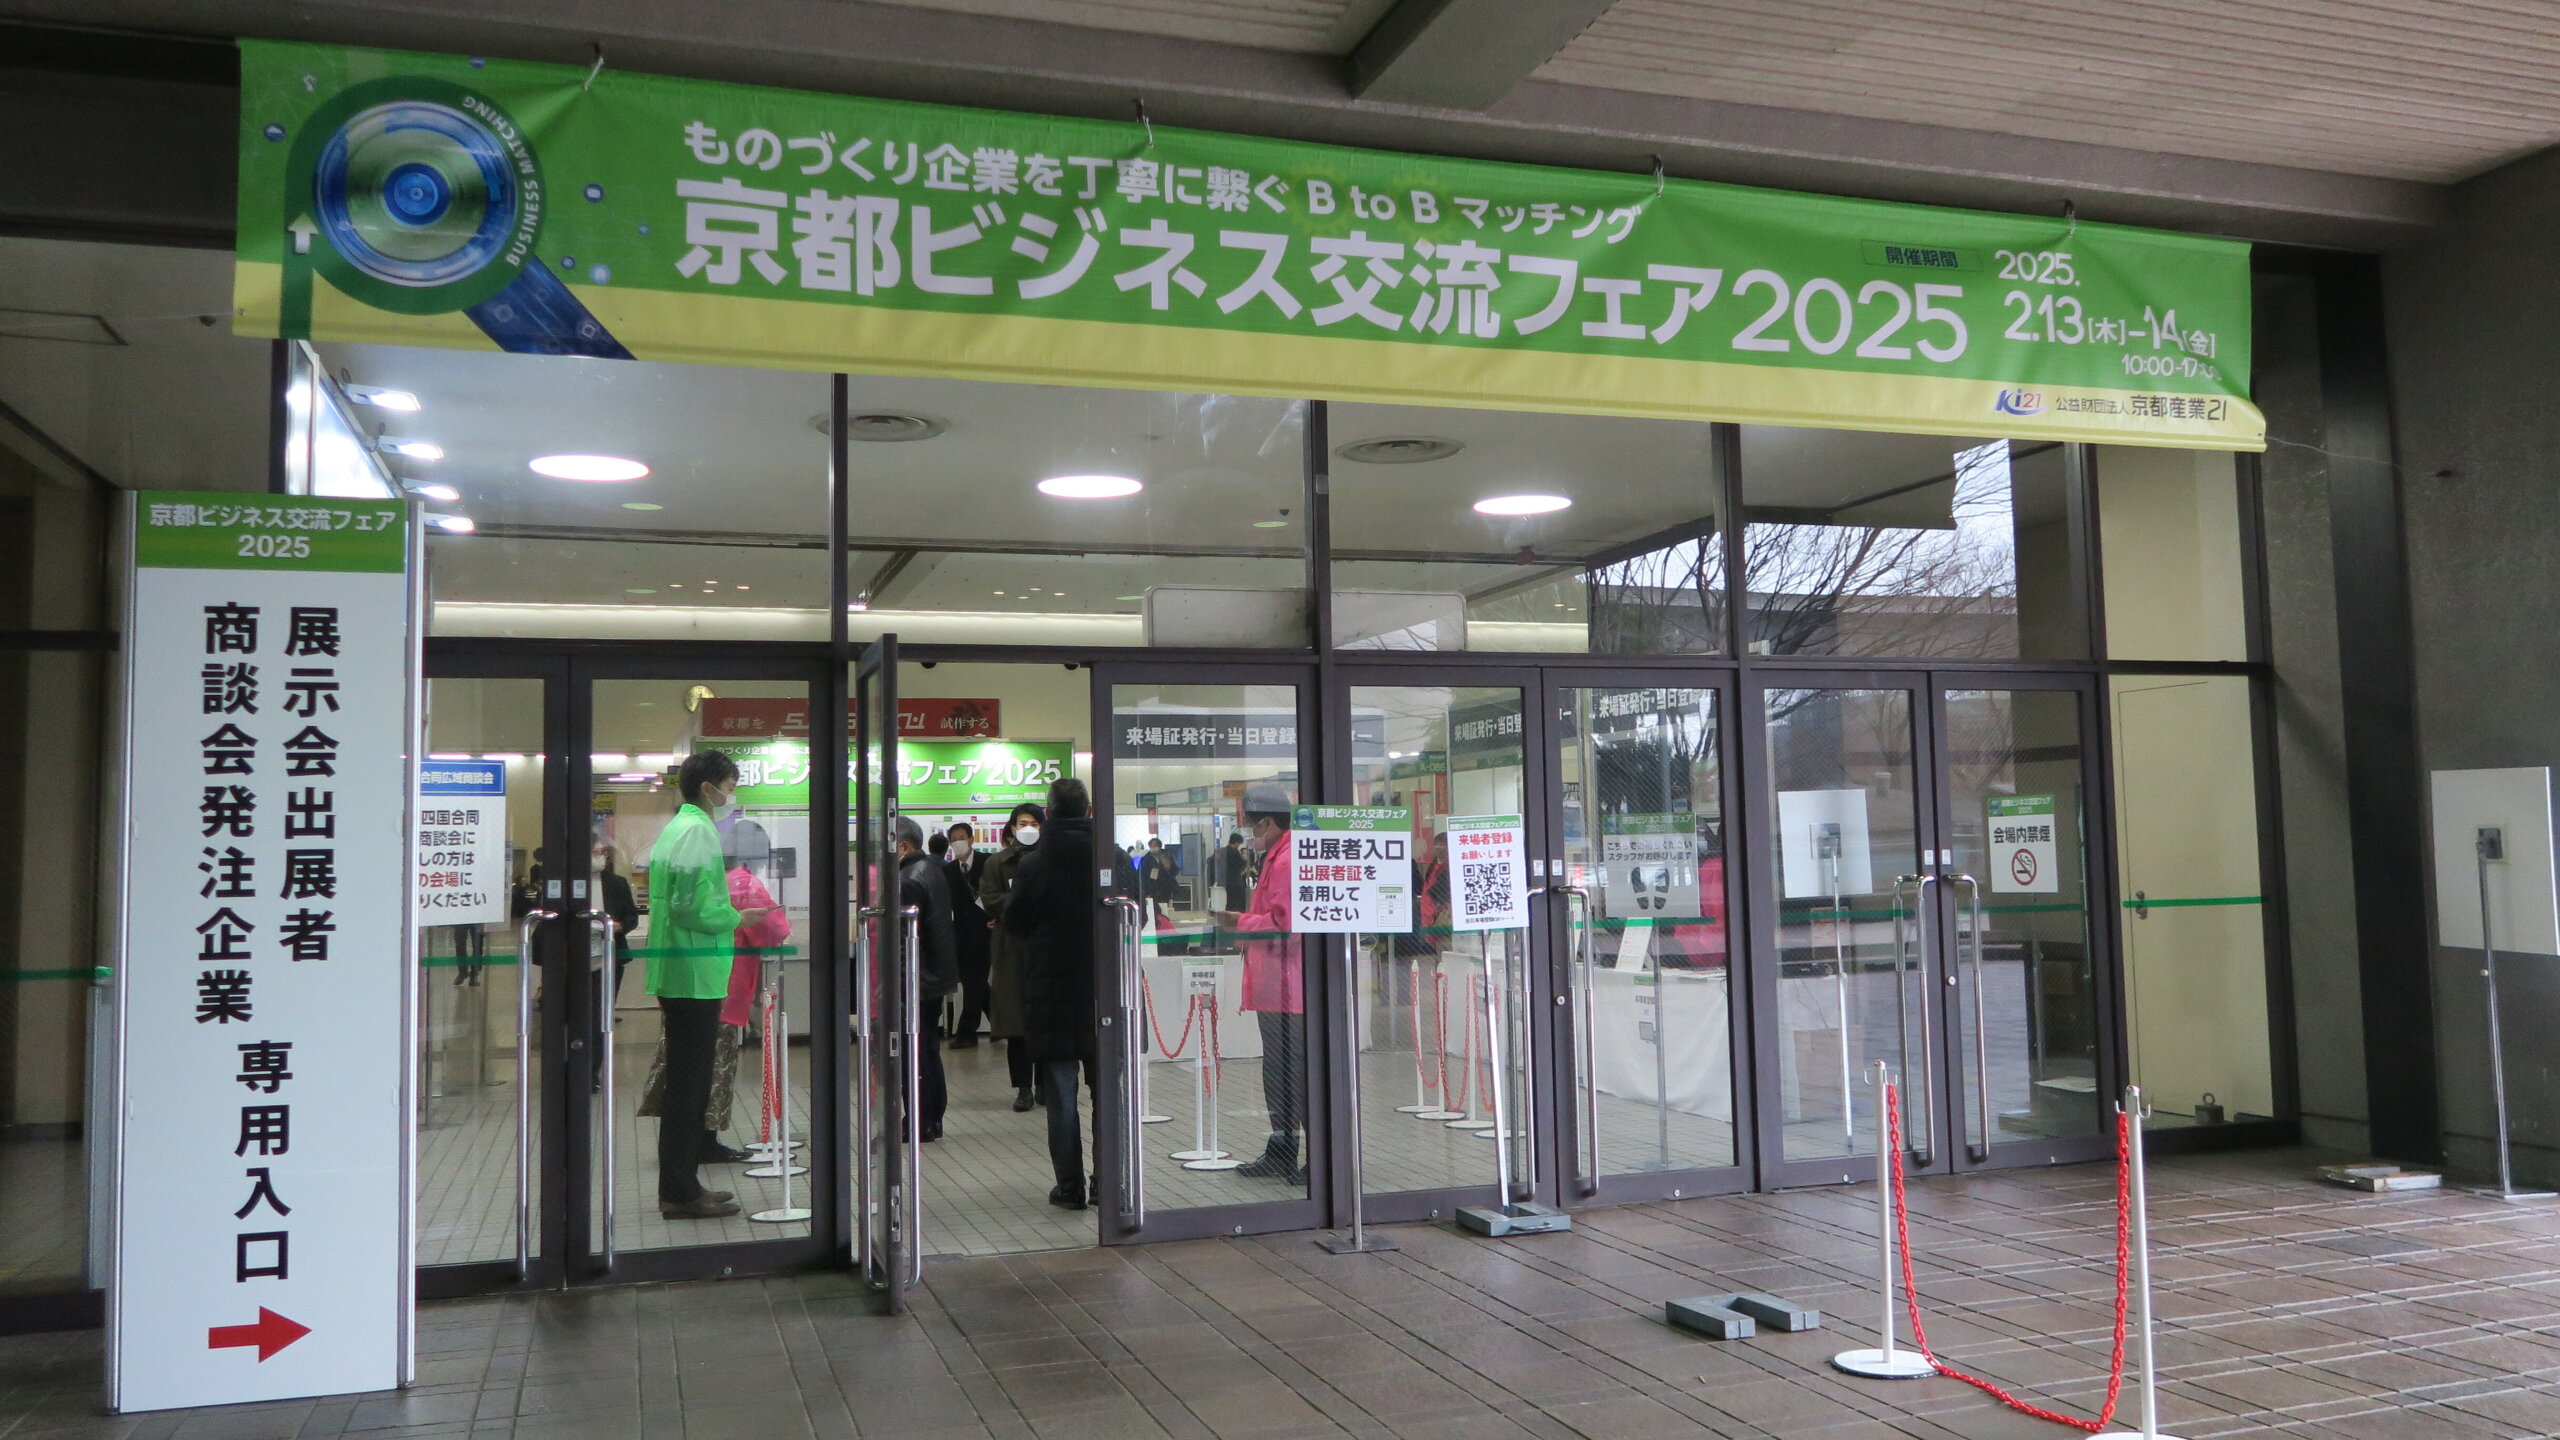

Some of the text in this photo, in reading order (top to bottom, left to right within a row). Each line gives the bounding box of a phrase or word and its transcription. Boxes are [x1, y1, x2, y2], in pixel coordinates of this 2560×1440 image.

[462, 95, 541, 269] BUSINESS MATCHING
[683, 119, 1643, 246] ものづくり企業を丁寧に繋ぐ B to B マッチング
[1884, 245, 1959, 271] 開催期間
[148, 502, 397, 533] 京都ビジネス交流フェア
[237, 533, 312, 560] 2025
[279, 605, 342, 963] 展示会出展者
[195, 600, 261, 1025] 商談会発注企業
[1317, 807, 1408, 822] 京都ビジネス交流フェア
[1348, 819, 1374, 830] 2025
[1458, 831, 1513, 846] 来場者登録
[1993, 825, 2051, 844] 会場内禁煙
[1297, 837, 1405, 861] 出展者入口
[1460, 849, 1513, 860] お願いします
[1298, 864, 1377, 882] 出展者証を
[1298, 885, 1361, 903] 着用して
[1298, 905, 1360, 922] ください
[233, 1039, 294, 1284] 専用入口
